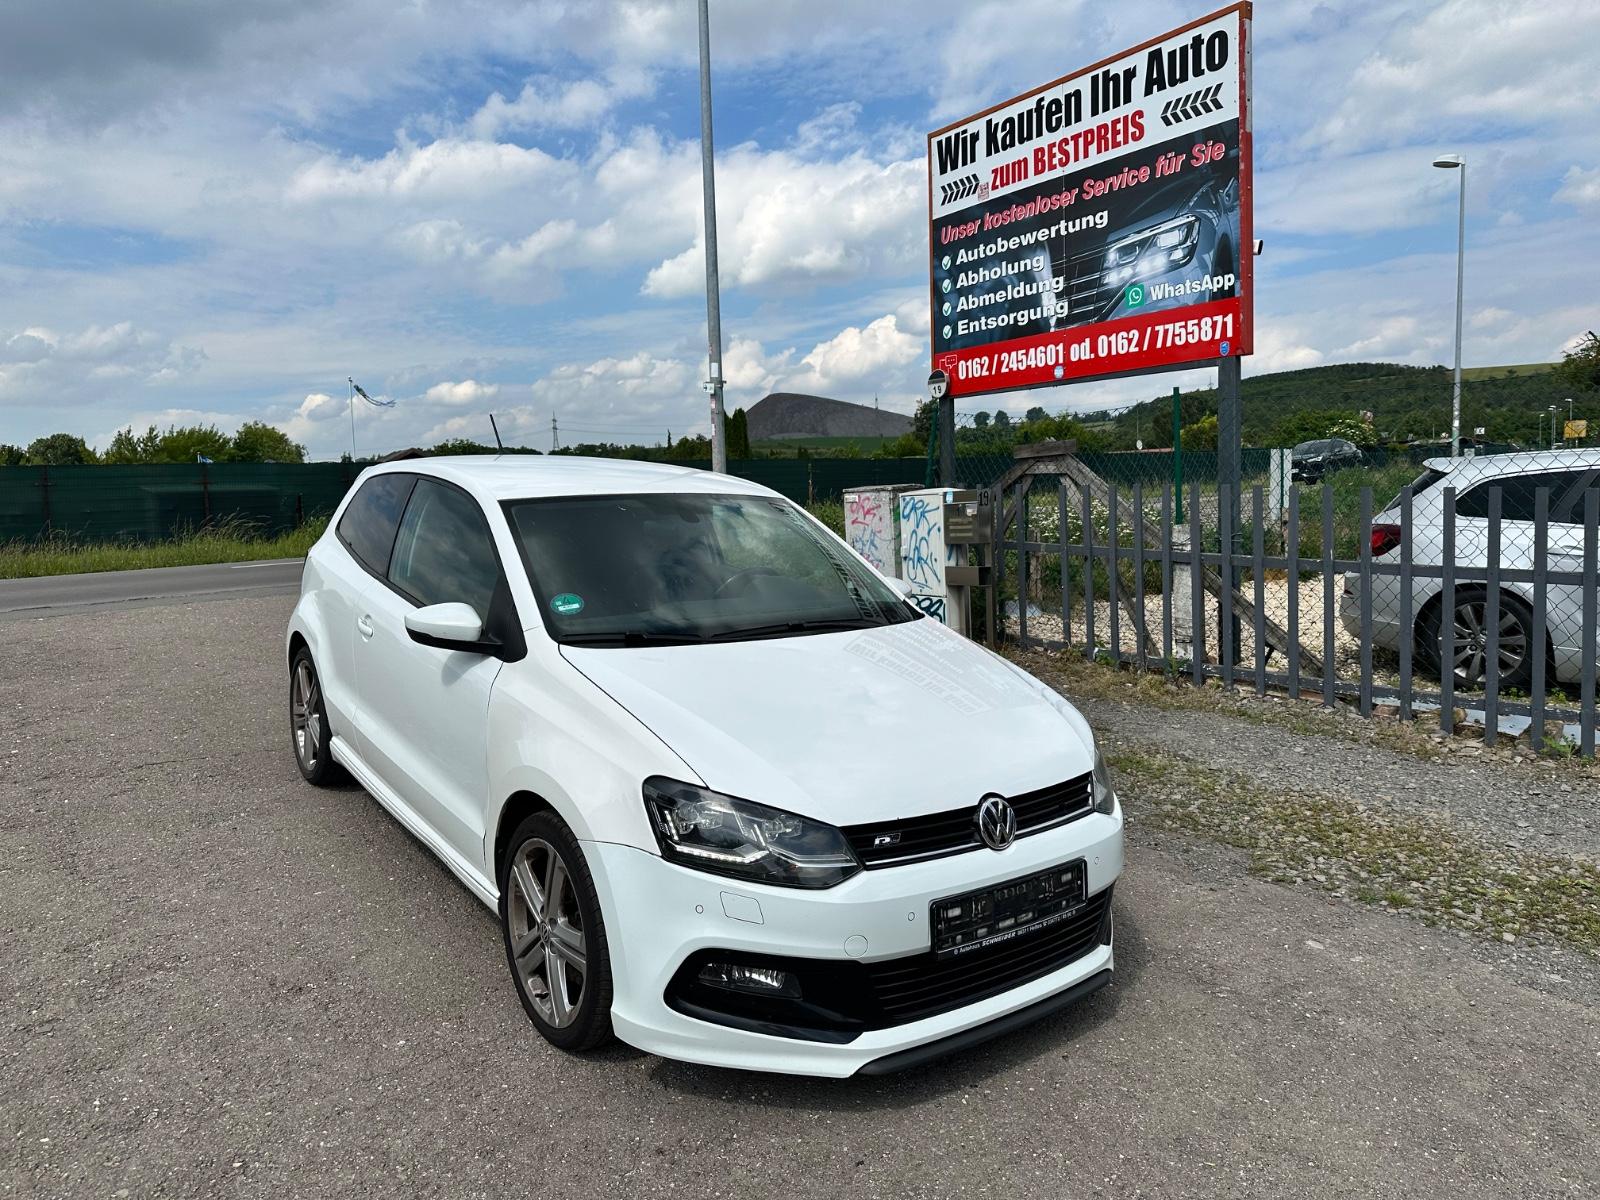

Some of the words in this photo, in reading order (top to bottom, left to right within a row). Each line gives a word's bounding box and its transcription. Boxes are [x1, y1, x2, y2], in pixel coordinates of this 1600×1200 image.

[937, 129, 979, 175] Wir
[985, 89, 1082, 157] kaufen
[1091, 65, 1137, 117] Ihr
[1144, 30, 1228, 97] Auto
[991, 156, 1028, 191] zum
[1034, 110, 1144, 176] BESTPREIS
[941, 219, 980, 245] Unser
[984, 188, 1079, 231] kostenloser
[1082, 165, 1150, 200] Service
[1155, 152, 1186, 178] für
[1190, 140, 1225, 167] Sie
[956, 210, 1109, 265] Autobewertung
[956, 255, 1045, 289] Abholung
[1150, 273, 1235, 300] WhatsApp
[956, 275, 1064, 313] Abmeldung
[957, 301, 1069, 336] Entsorgung
[958, 356, 990, 380] 0162
[1000, 343, 1064, 373] 2454601
[1070, 337, 1095, 361] od.
[1097, 329, 1140, 357] 0162
[1154, 313, 1233, 349] 7755871
[933, 385, 942, 395] 19
[979, 490, 989, 506] 19
[981, 931, 1016, 947] SCHNEIDER
